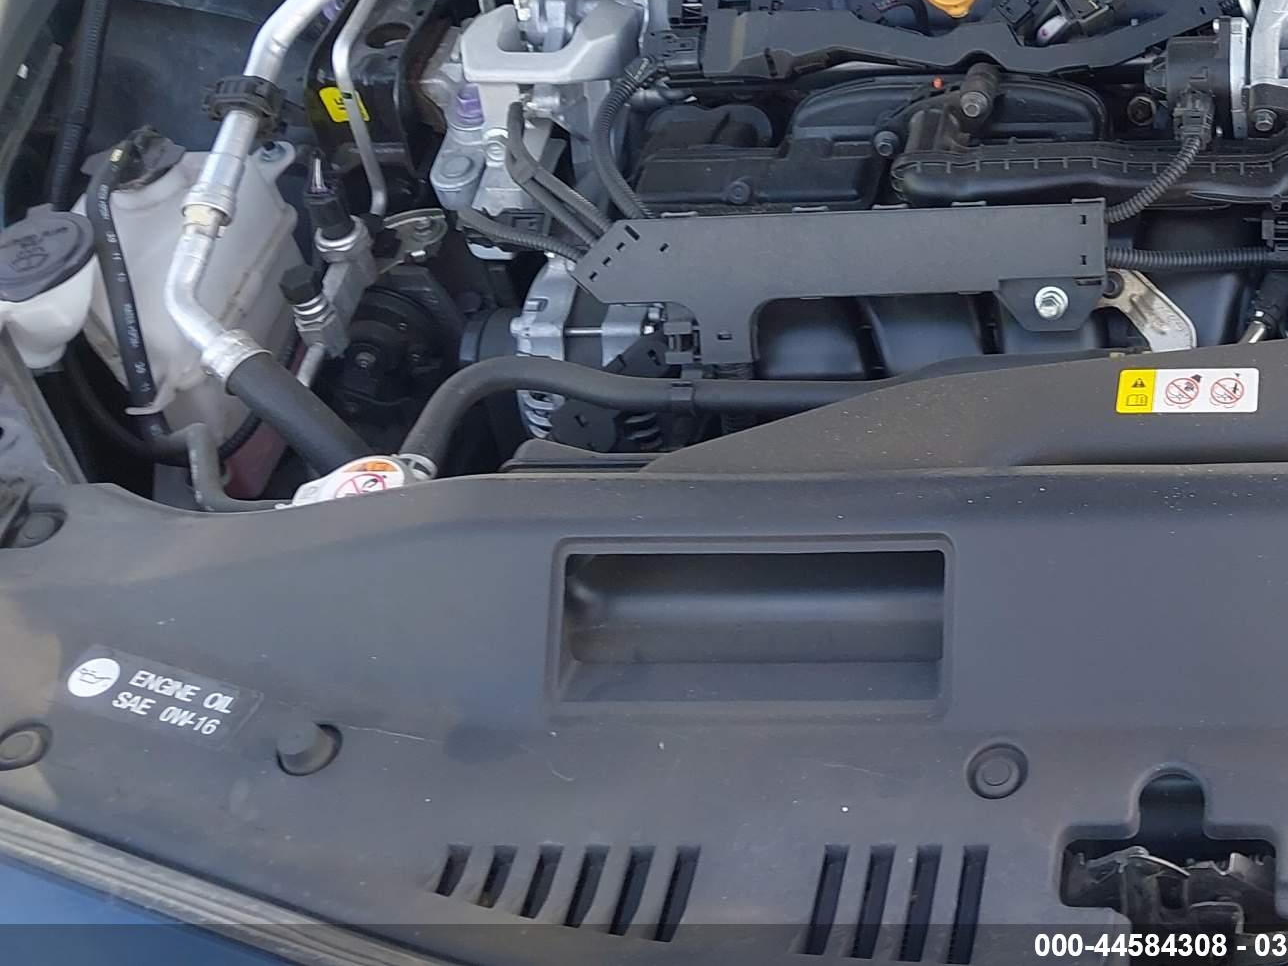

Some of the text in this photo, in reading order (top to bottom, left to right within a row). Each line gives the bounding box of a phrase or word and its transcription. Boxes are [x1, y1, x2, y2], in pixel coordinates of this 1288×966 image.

[111, 691, 221, 735] SAE 0W-16
[128, 670, 235, 714] ENGINE OIL
